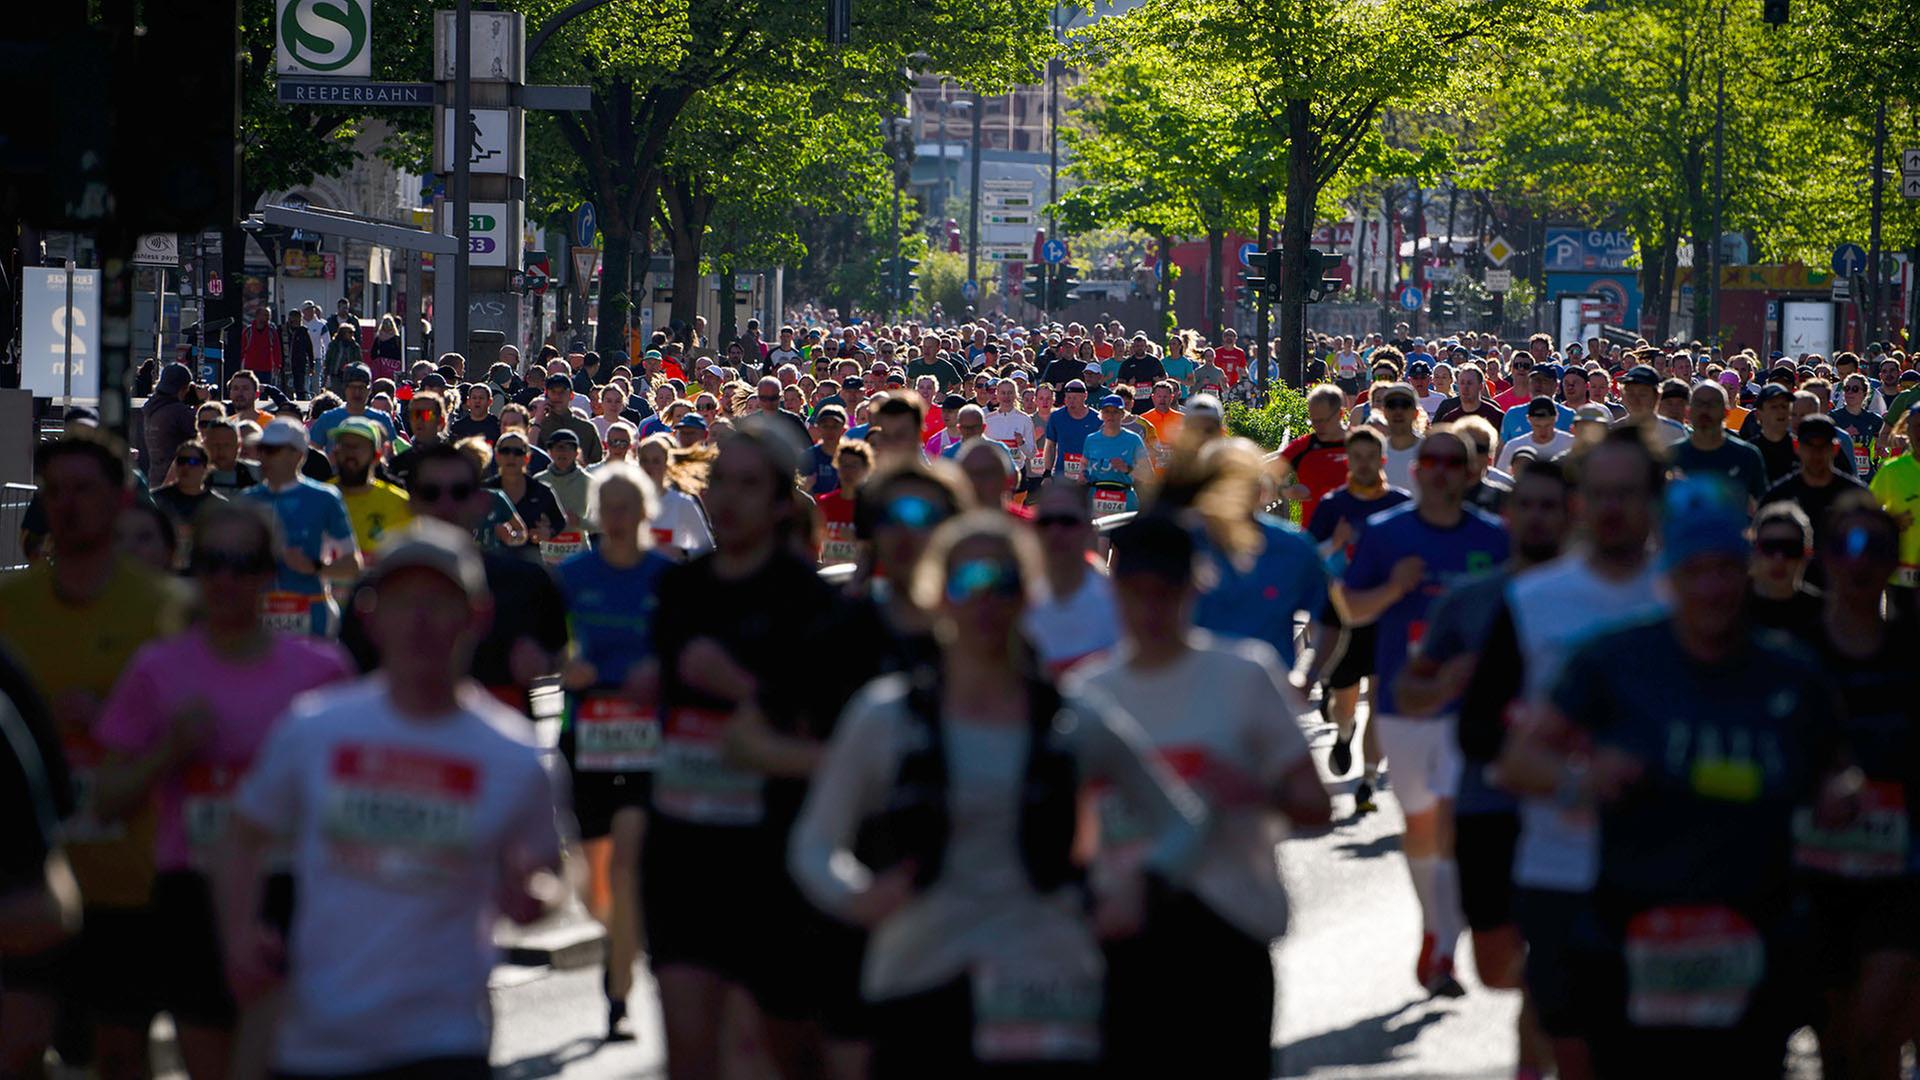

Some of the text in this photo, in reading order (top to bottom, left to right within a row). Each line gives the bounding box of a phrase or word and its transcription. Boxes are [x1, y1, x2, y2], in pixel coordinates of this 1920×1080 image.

[295, 0, 353, 65] S
[296, 86, 417, 101] REEPERBAHN
[1557, 244, 1573, 265] P
